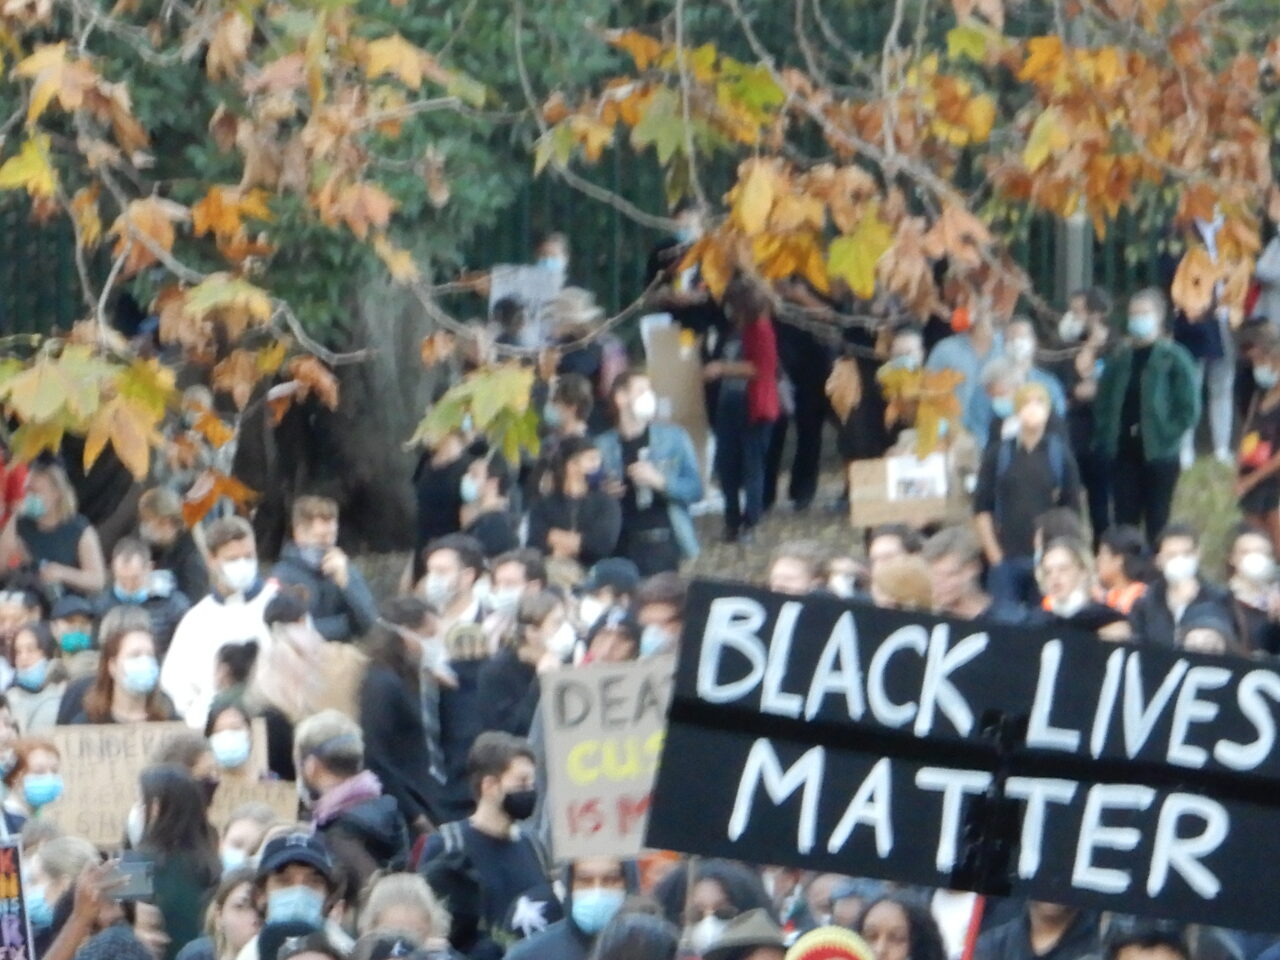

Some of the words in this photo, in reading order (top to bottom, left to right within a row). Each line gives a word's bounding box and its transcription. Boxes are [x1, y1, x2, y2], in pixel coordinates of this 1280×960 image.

[696, 596, 989, 739] BLACK
[1026, 637, 1280, 771] LIVES
[727, 737, 1231, 899] MATTER
